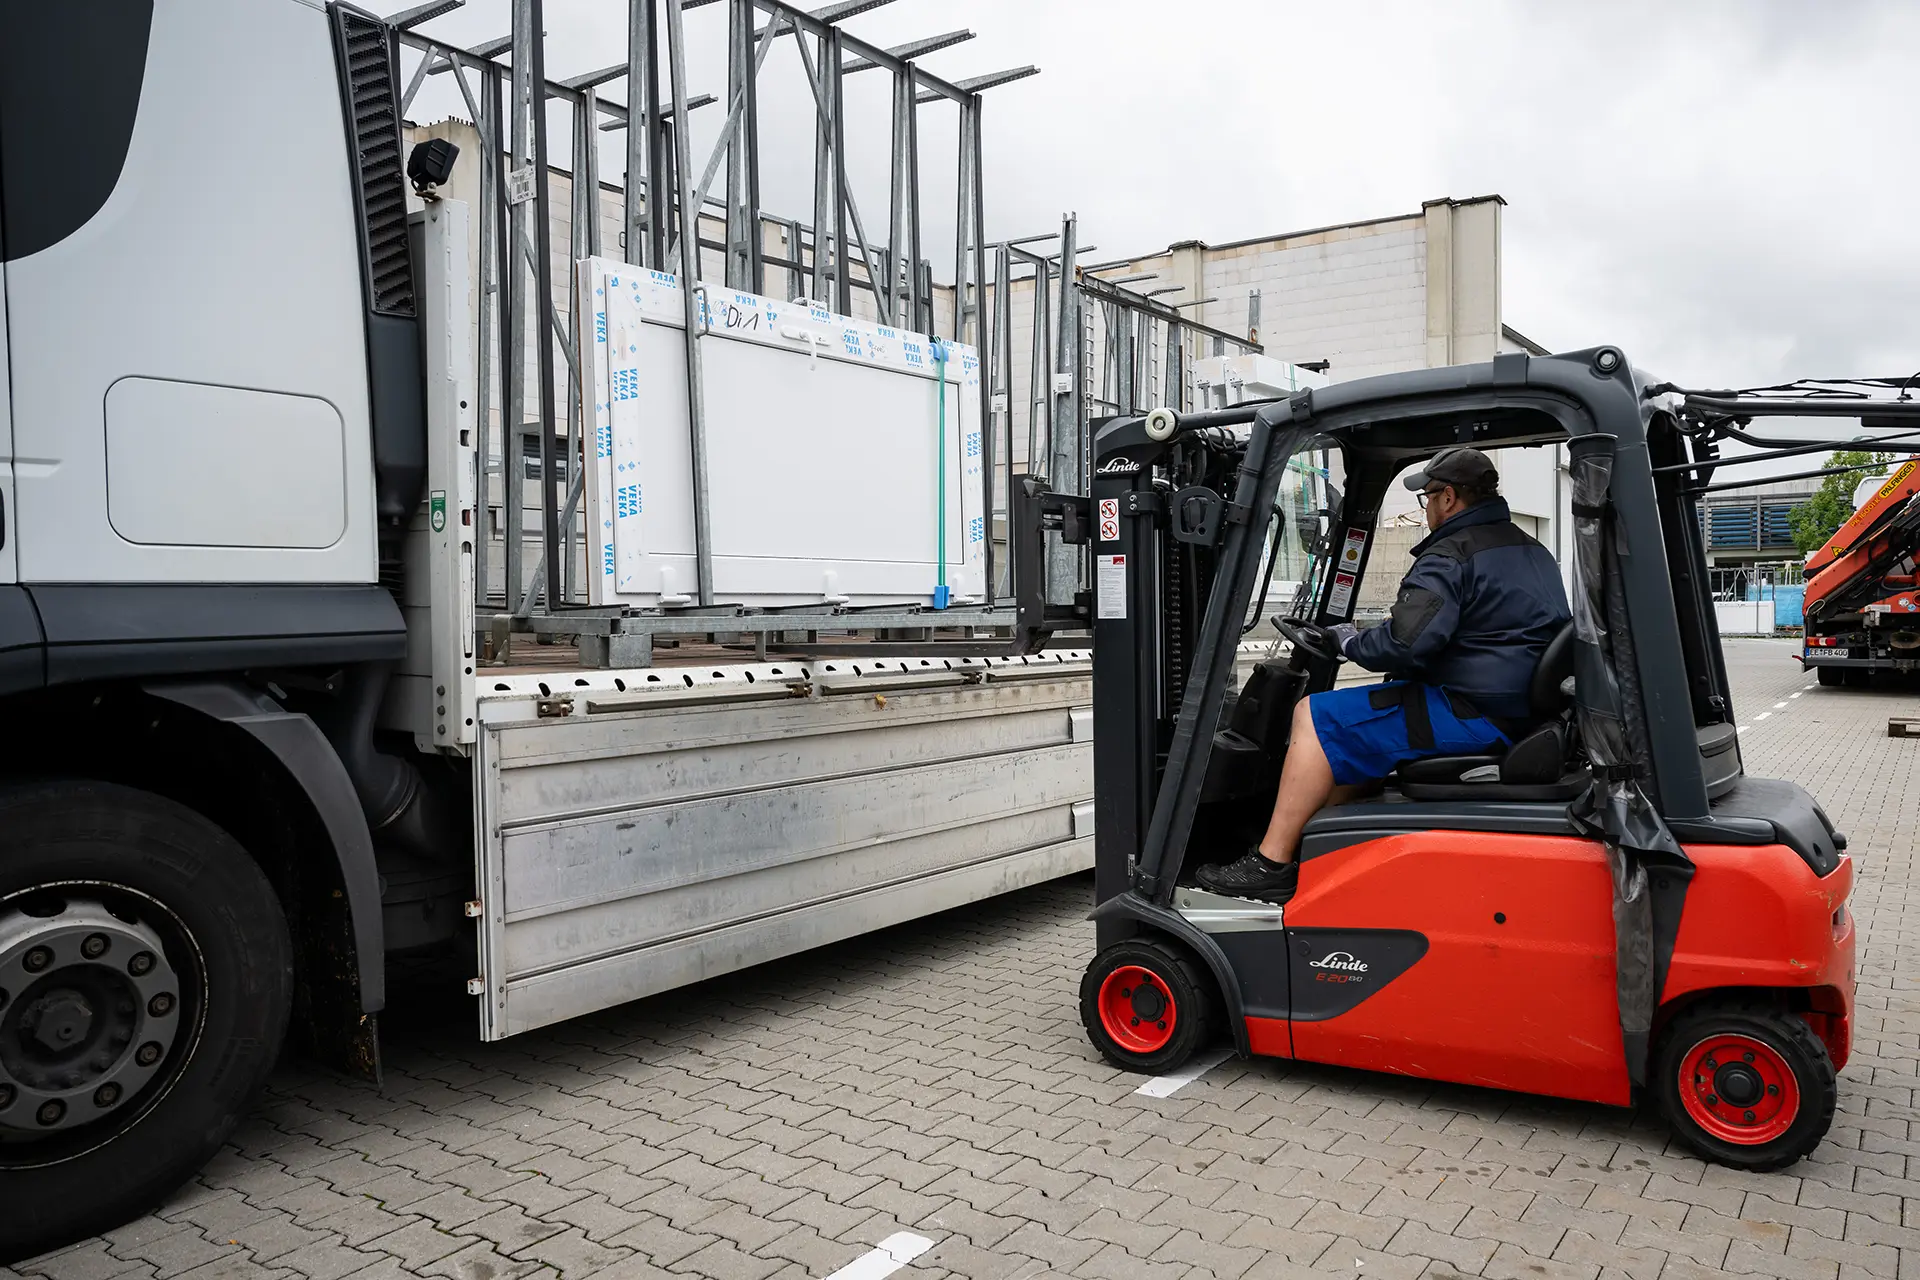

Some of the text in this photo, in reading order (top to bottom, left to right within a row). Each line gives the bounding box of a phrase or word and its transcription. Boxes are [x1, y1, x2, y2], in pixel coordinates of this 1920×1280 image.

[650, 271, 675, 283] VEKA
[735, 295, 757, 307] VEKA
[810, 309, 830, 319] VEKA
[596, 312, 606, 343] VEKA
[877, 328, 896, 339] VEKA
[903, 342, 921, 353] VEKA
[905, 353, 922, 364] VEKA
[619, 370, 629, 401] VEKA
[629, 368, 639, 399] VEKA
[597, 427, 605, 458] VEKA
[1096, 456, 1140, 473] Linde
[1881, 463, 1915, 497] PALFINGER
[618, 487, 628, 518] VEKA
[628, 484, 638, 516] VEKA
[604, 543, 614, 575] VEKA
[1309, 951, 1368, 972] Linde
[1315, 972, 1326, 981] E
[1327, 973, 1349, 983] 20
